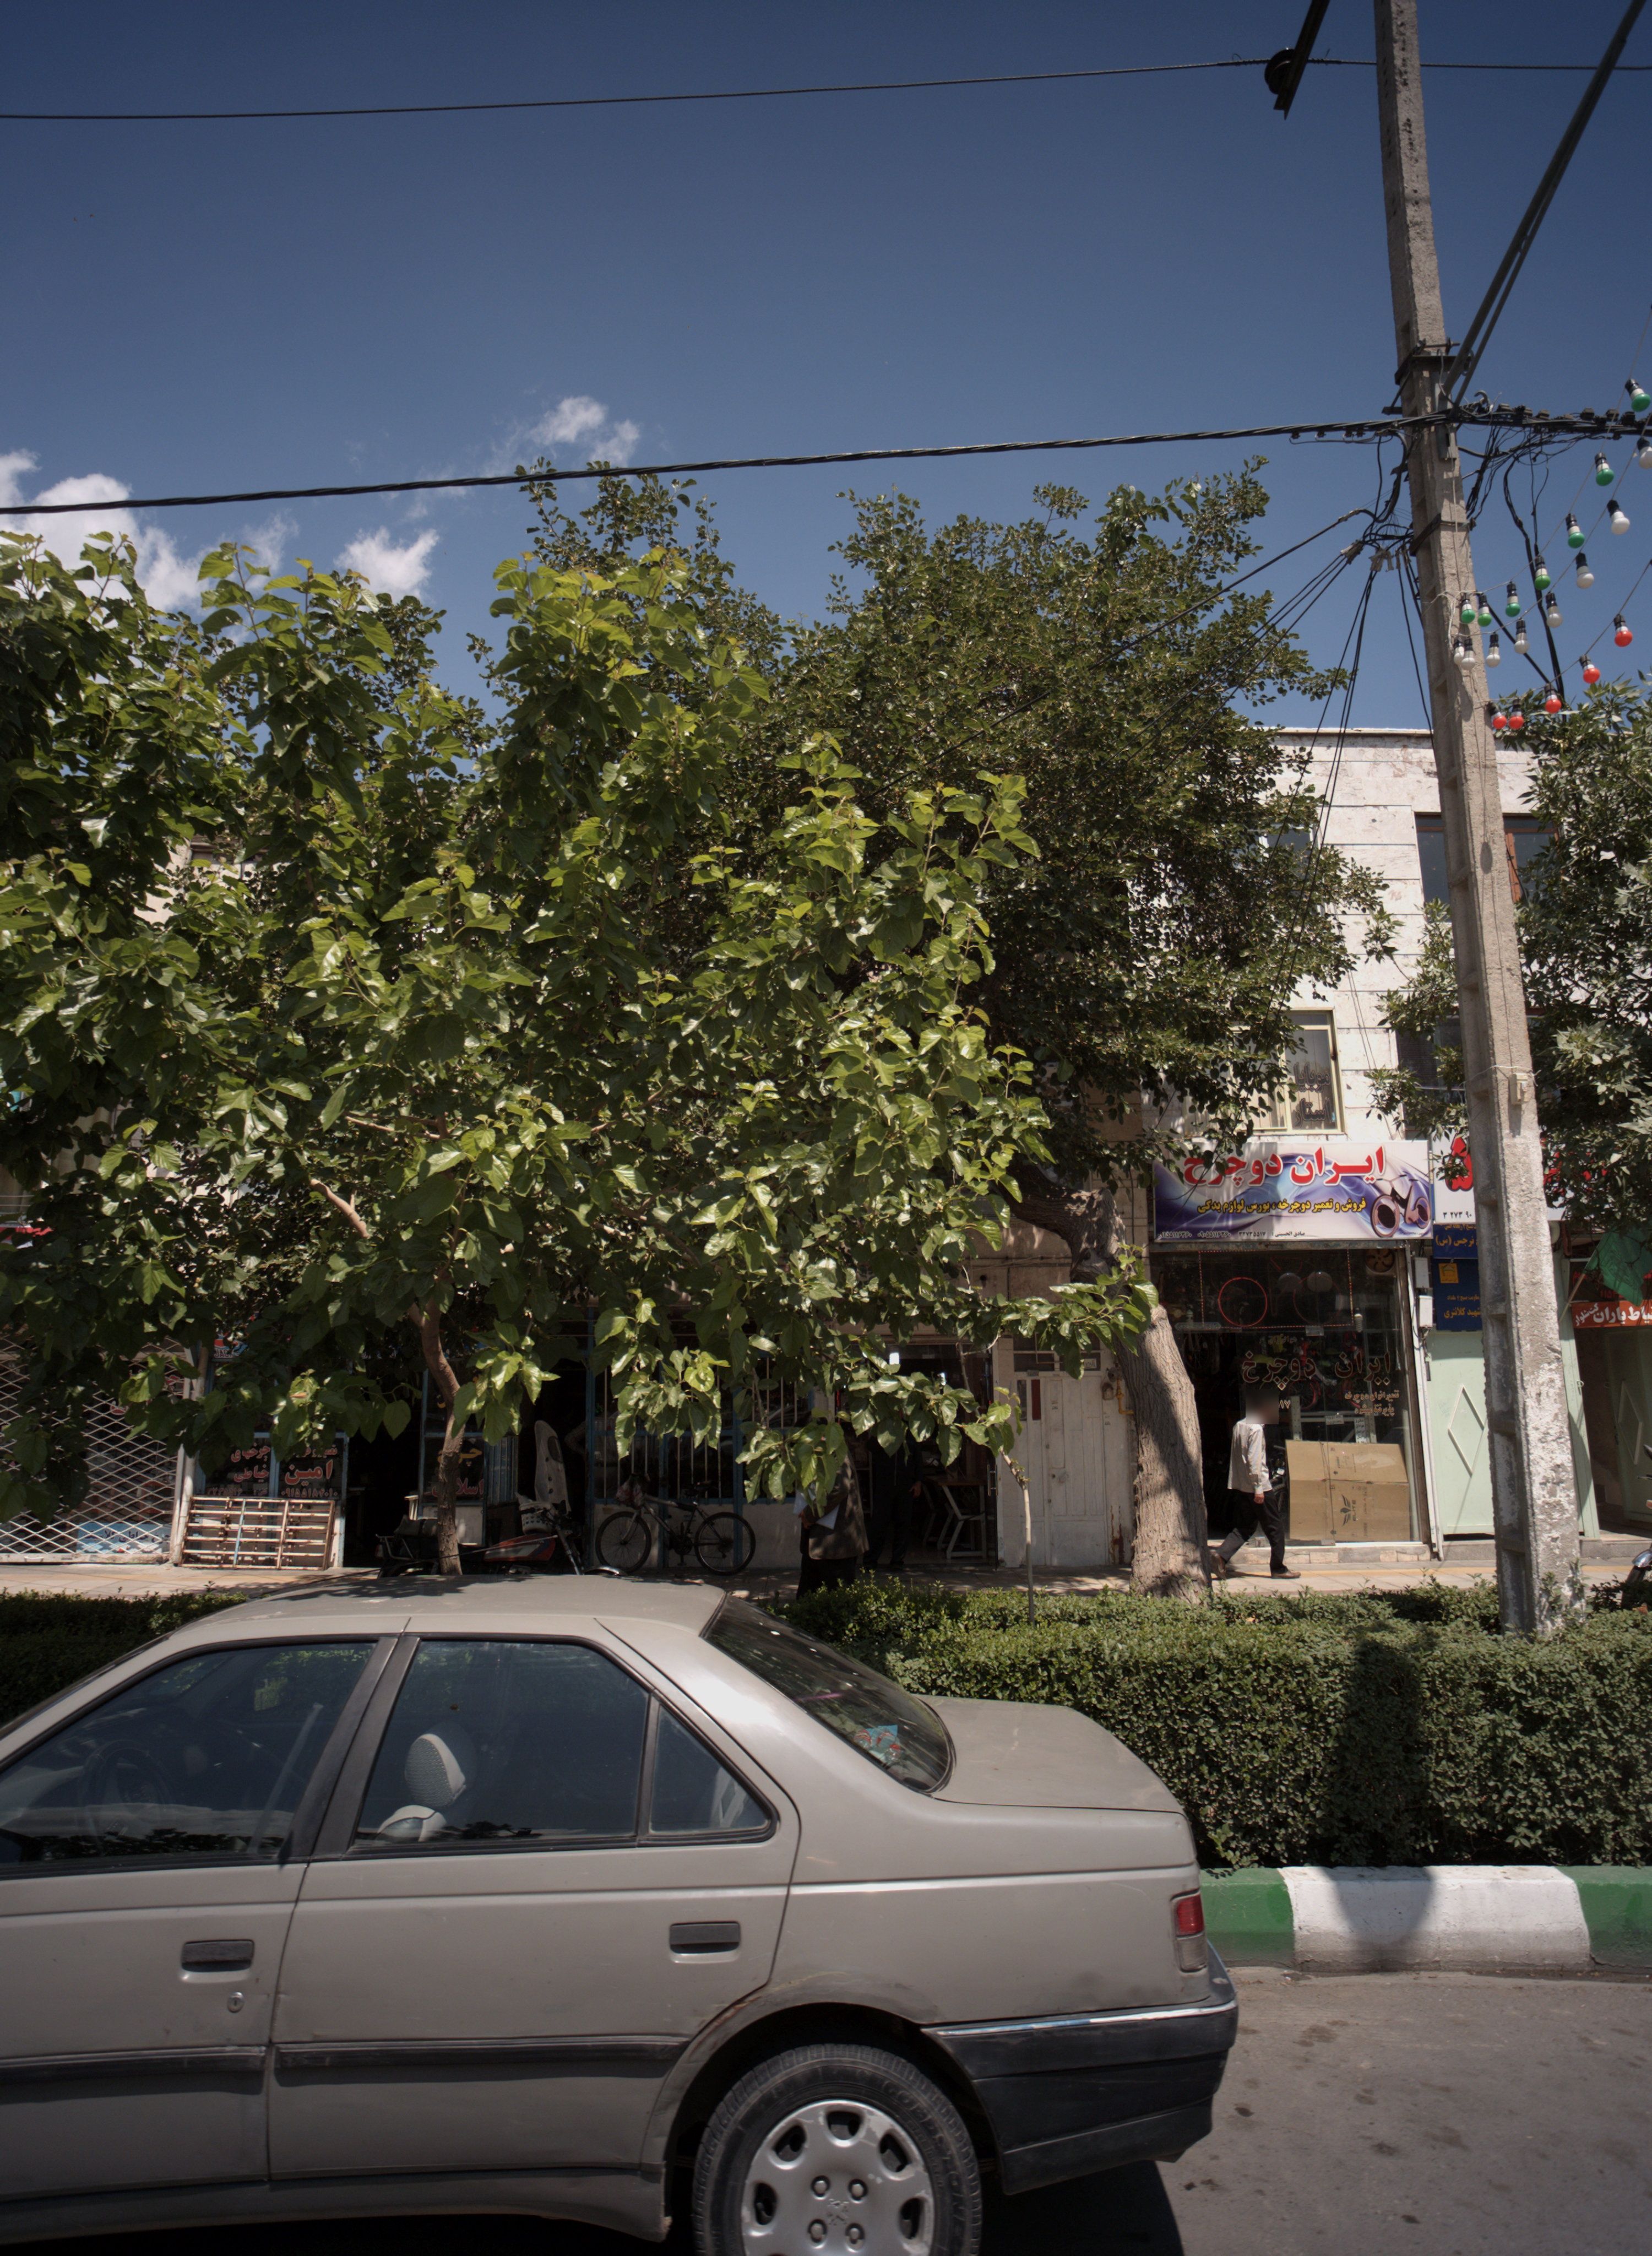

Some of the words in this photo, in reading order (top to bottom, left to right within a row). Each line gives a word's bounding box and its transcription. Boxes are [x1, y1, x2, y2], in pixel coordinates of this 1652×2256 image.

[1290, 1146, 1384, 1185] ایران
[1198, 1198, 1221, 1213] یدکی
[1222, 1198, 1245, 1213] لوازم
[1246, 1201, 1270, 1213] بورس
[1278, 1198, 1311, 1213] دوچرخه
[1312, 1198, 1333, 1213] تعمیر
[1334, 1202, 1341, 1212] و
[1341, 1197, 1366, 1212] فروش
[1627, 1305, 1652, 1324] یاط
[214, 1348, 236, 1359] JAC
[1242, 1350, 1318, 1391] دوچرخ
[1335, 1351, 1391, 1386] ایران
[233, 1463, 269, 1483] خیاطی
[285, 1459, 333, 1486] امین
